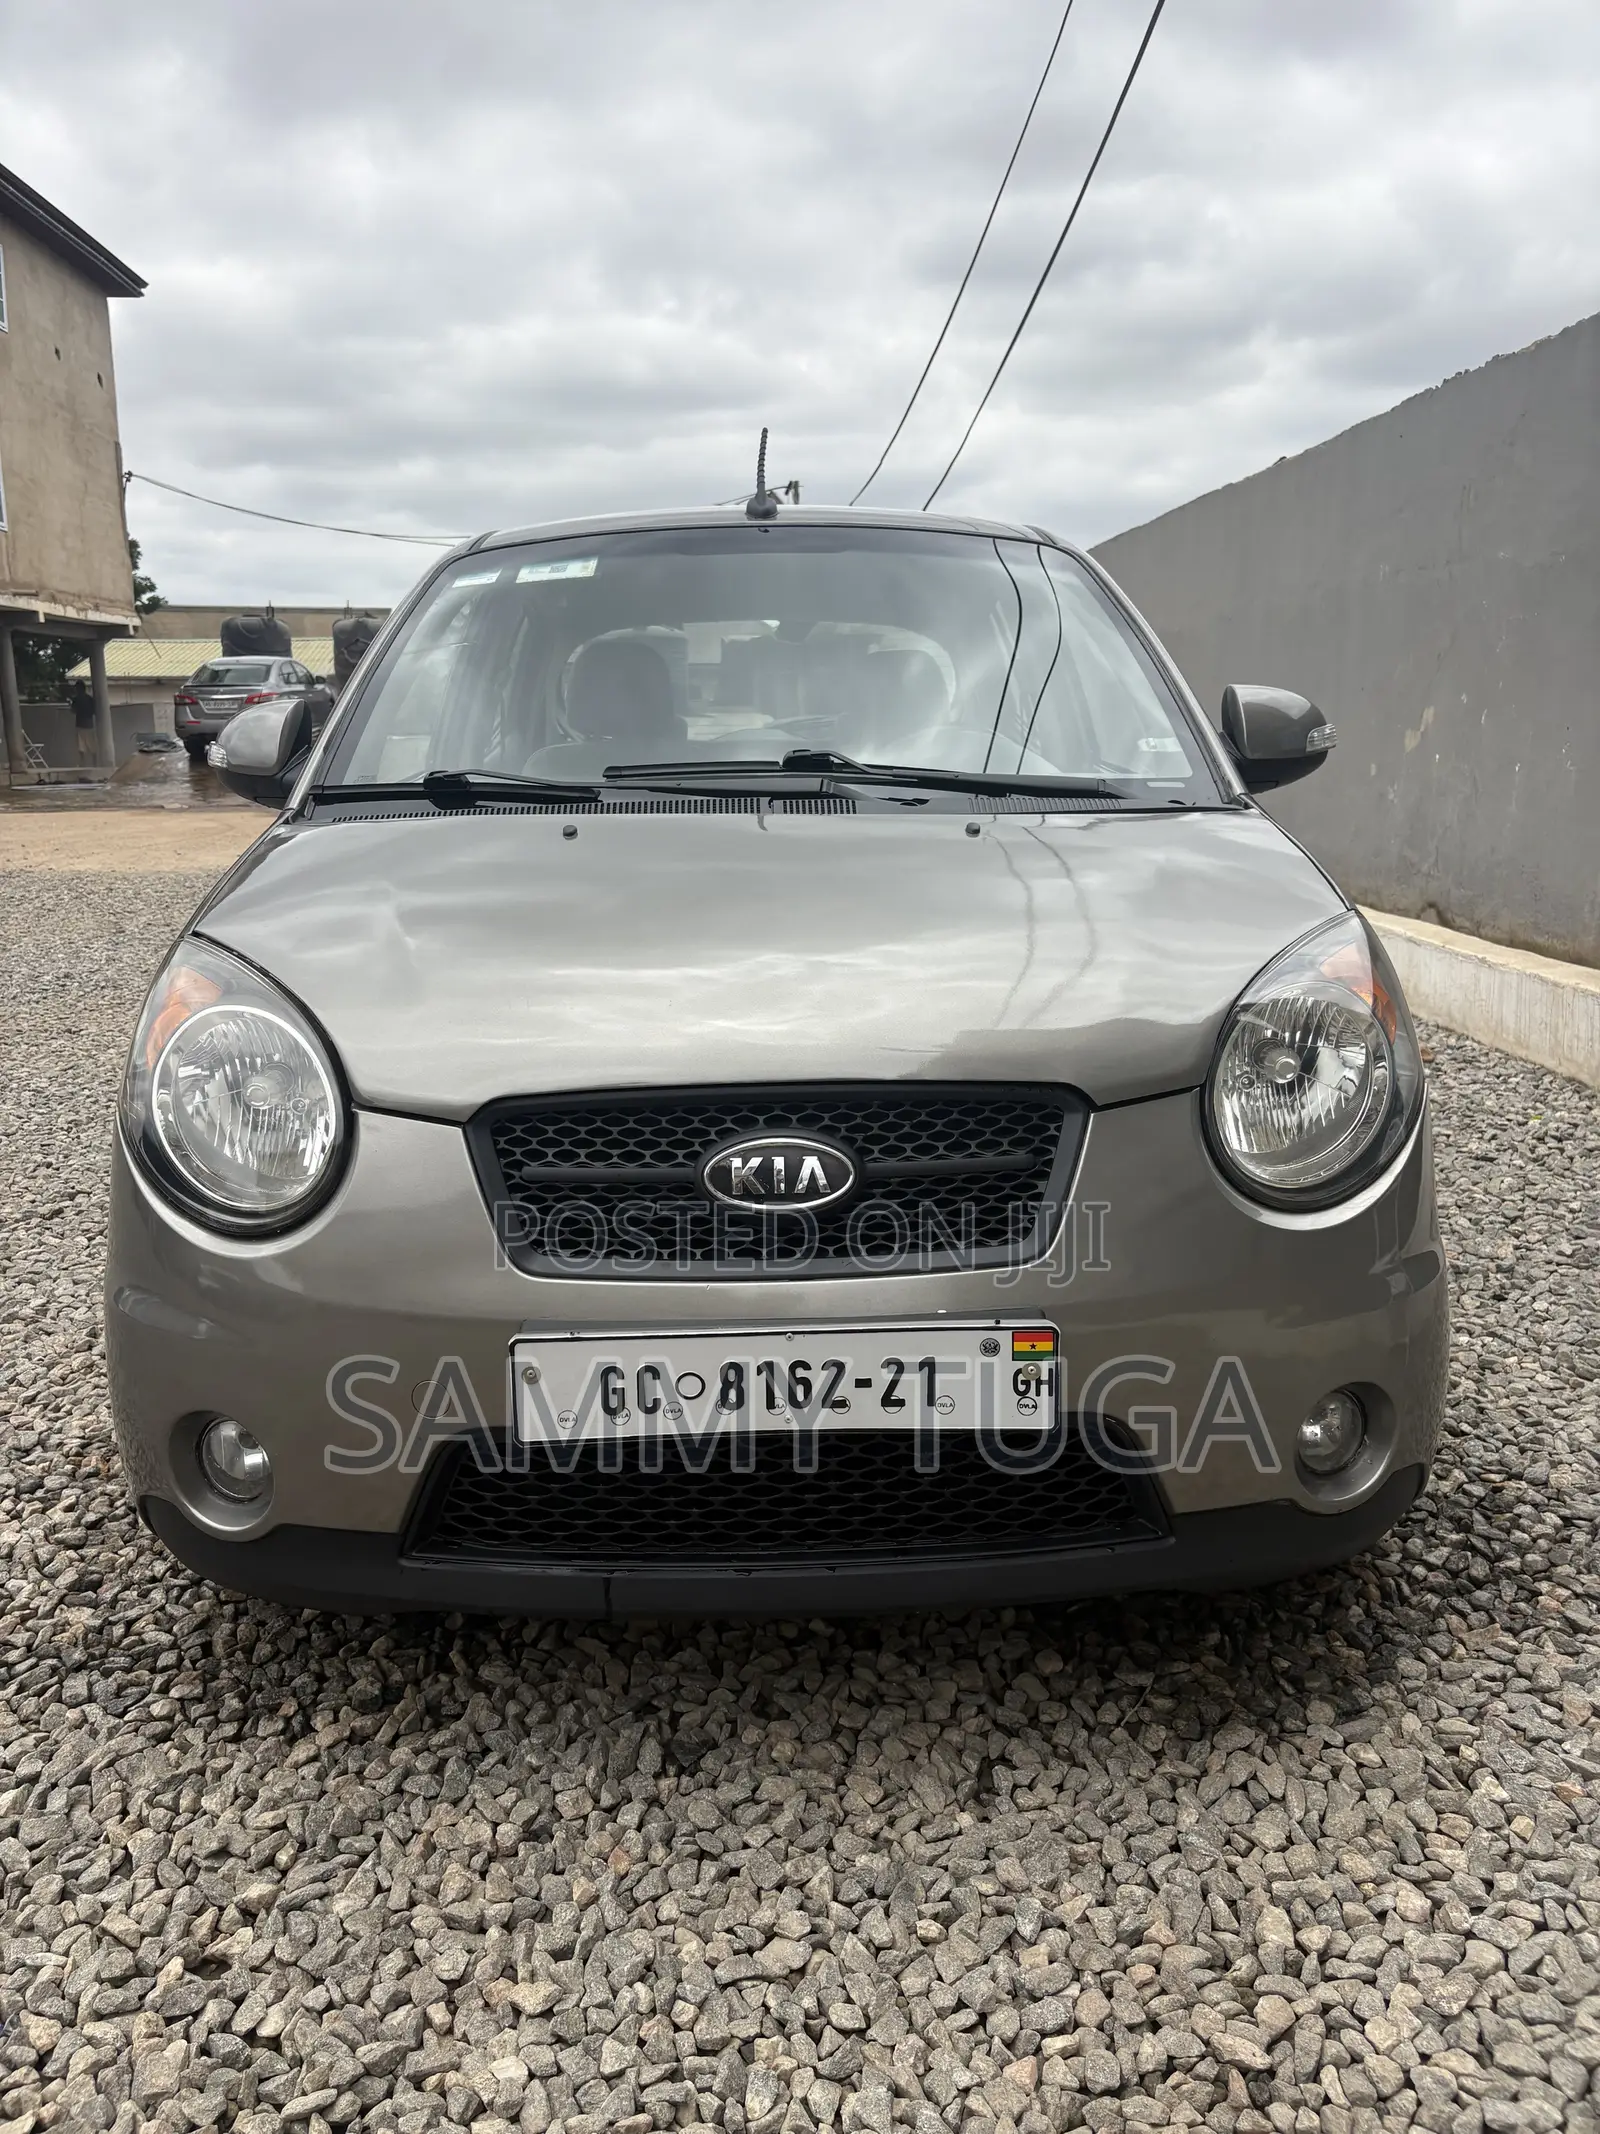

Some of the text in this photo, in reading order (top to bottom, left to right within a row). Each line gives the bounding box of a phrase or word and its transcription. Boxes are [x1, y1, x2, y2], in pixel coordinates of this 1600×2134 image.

[729, 1156, 832, 1195] KIA
[600, 1356, 936, 1416] GC 8162-21
[1012, 1367, 1054, 1397] GH
